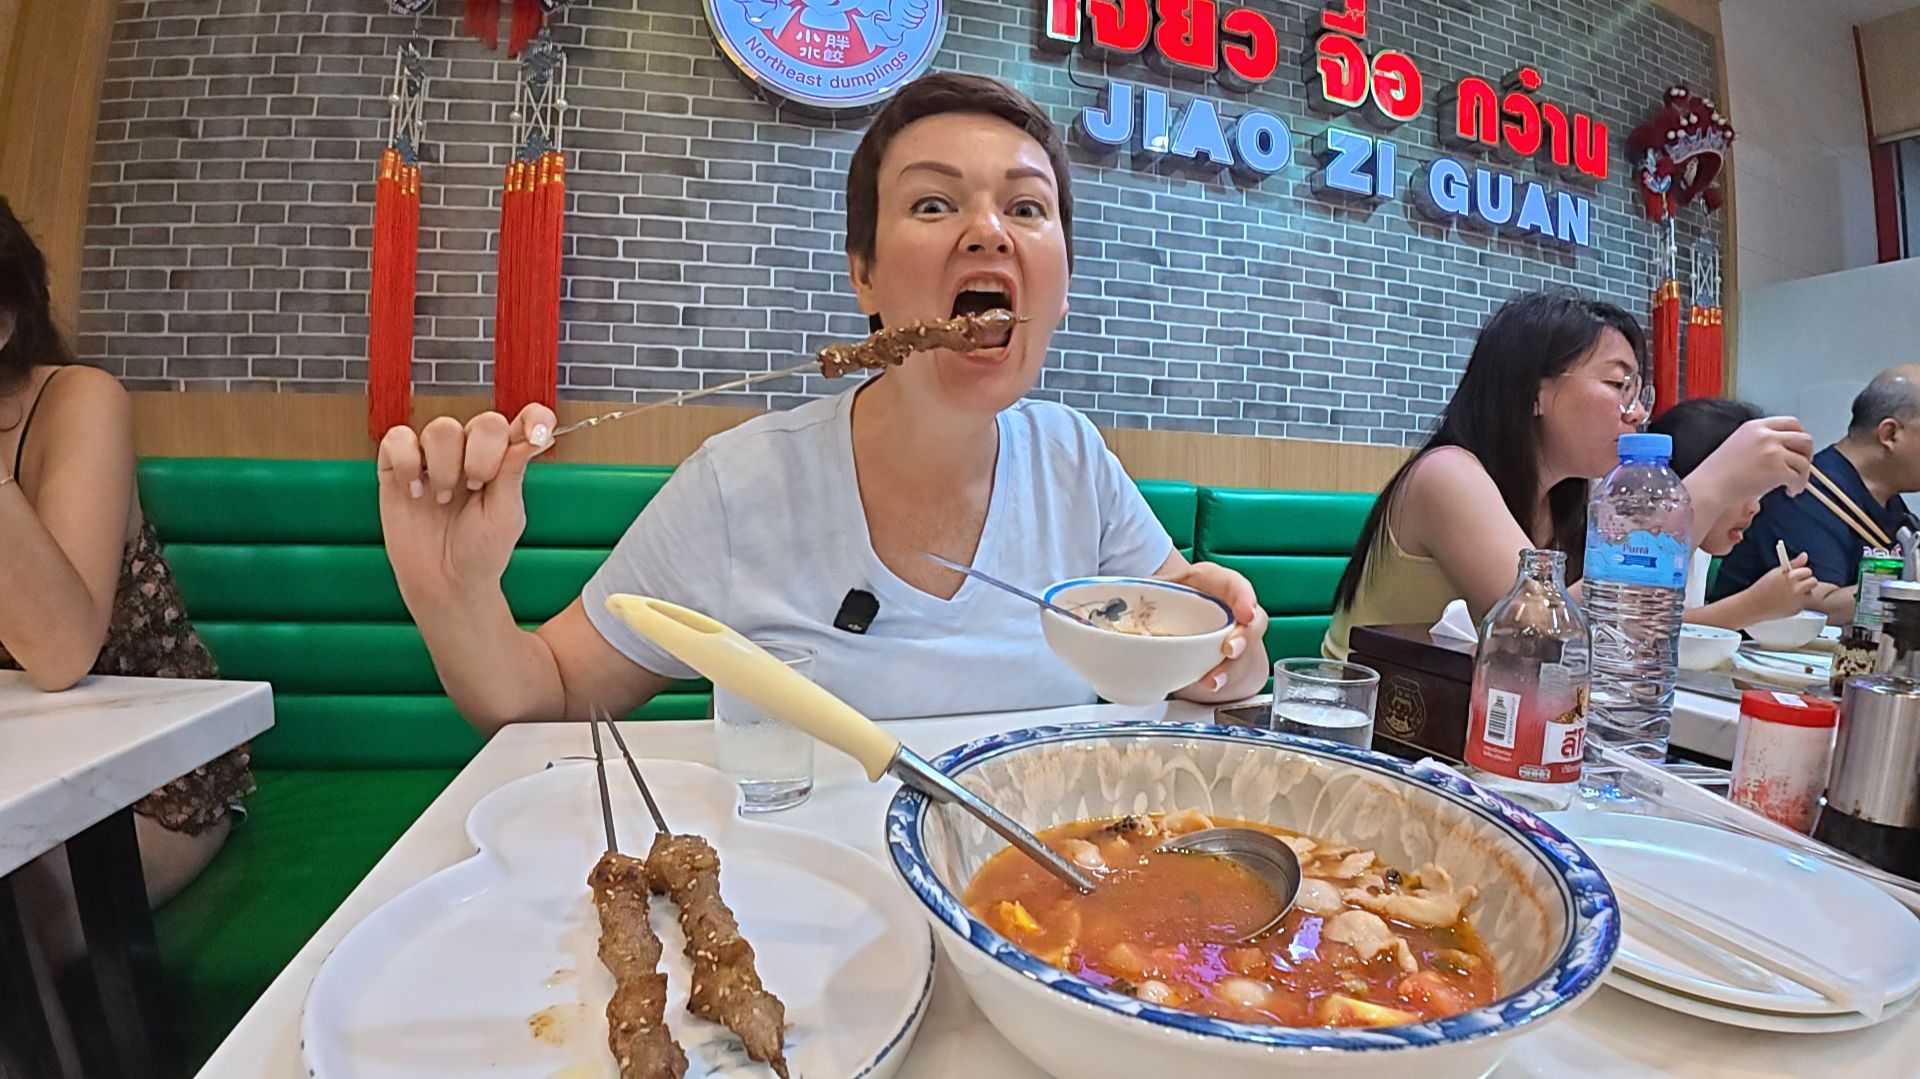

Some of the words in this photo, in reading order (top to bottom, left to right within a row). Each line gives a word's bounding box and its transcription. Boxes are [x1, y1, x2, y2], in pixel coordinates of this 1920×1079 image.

[745, 36, 822, 88] Northeast
[829, 50, 909, 89] dumplings
[1082, 81, 1293, 176] JIAO
[1325, 127, 1397, 201] ZI
[1428, 156, 1591, 248] GUAN
[1623, 543, 1649, 555] Purra
[1561, 727, 1585, 758] ลีโ
